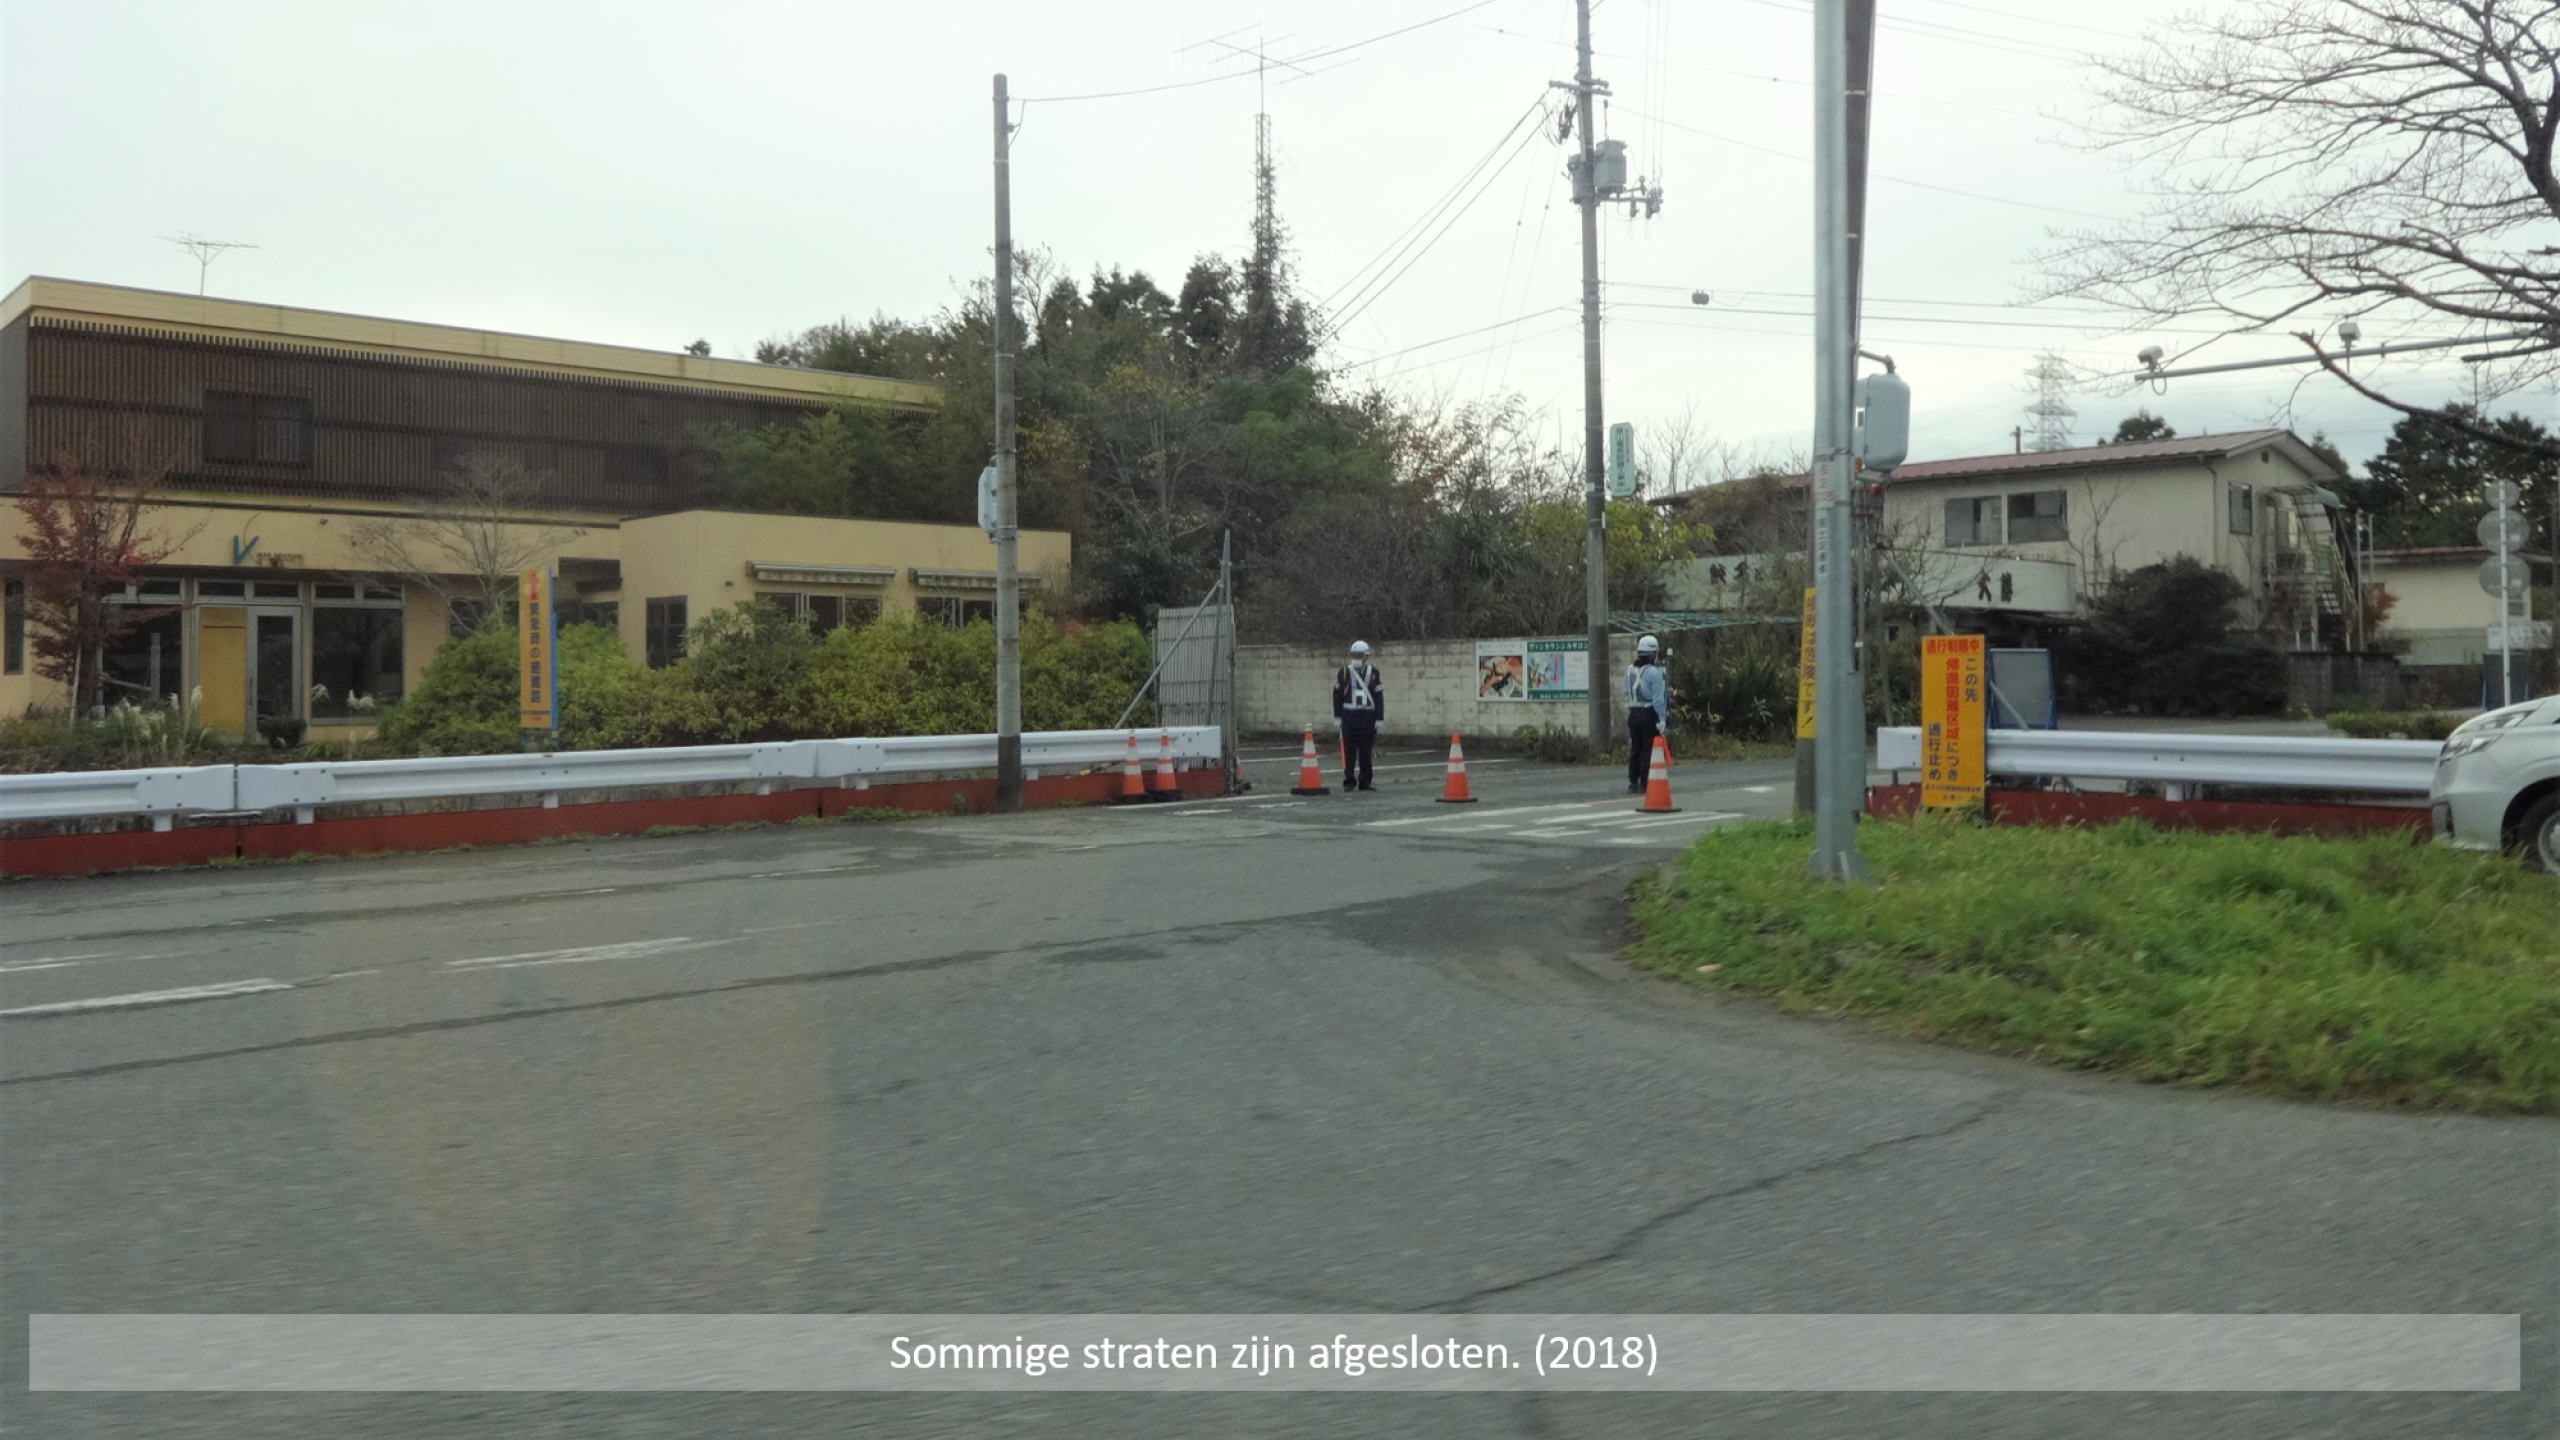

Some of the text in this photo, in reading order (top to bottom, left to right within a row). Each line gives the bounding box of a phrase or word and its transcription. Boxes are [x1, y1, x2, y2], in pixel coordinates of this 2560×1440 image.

[1926, 638, 1980, 653] 通行制限中
[1965, 658, 1978, 702] この先
[1928, 722, 1941, 781] 通行止め
